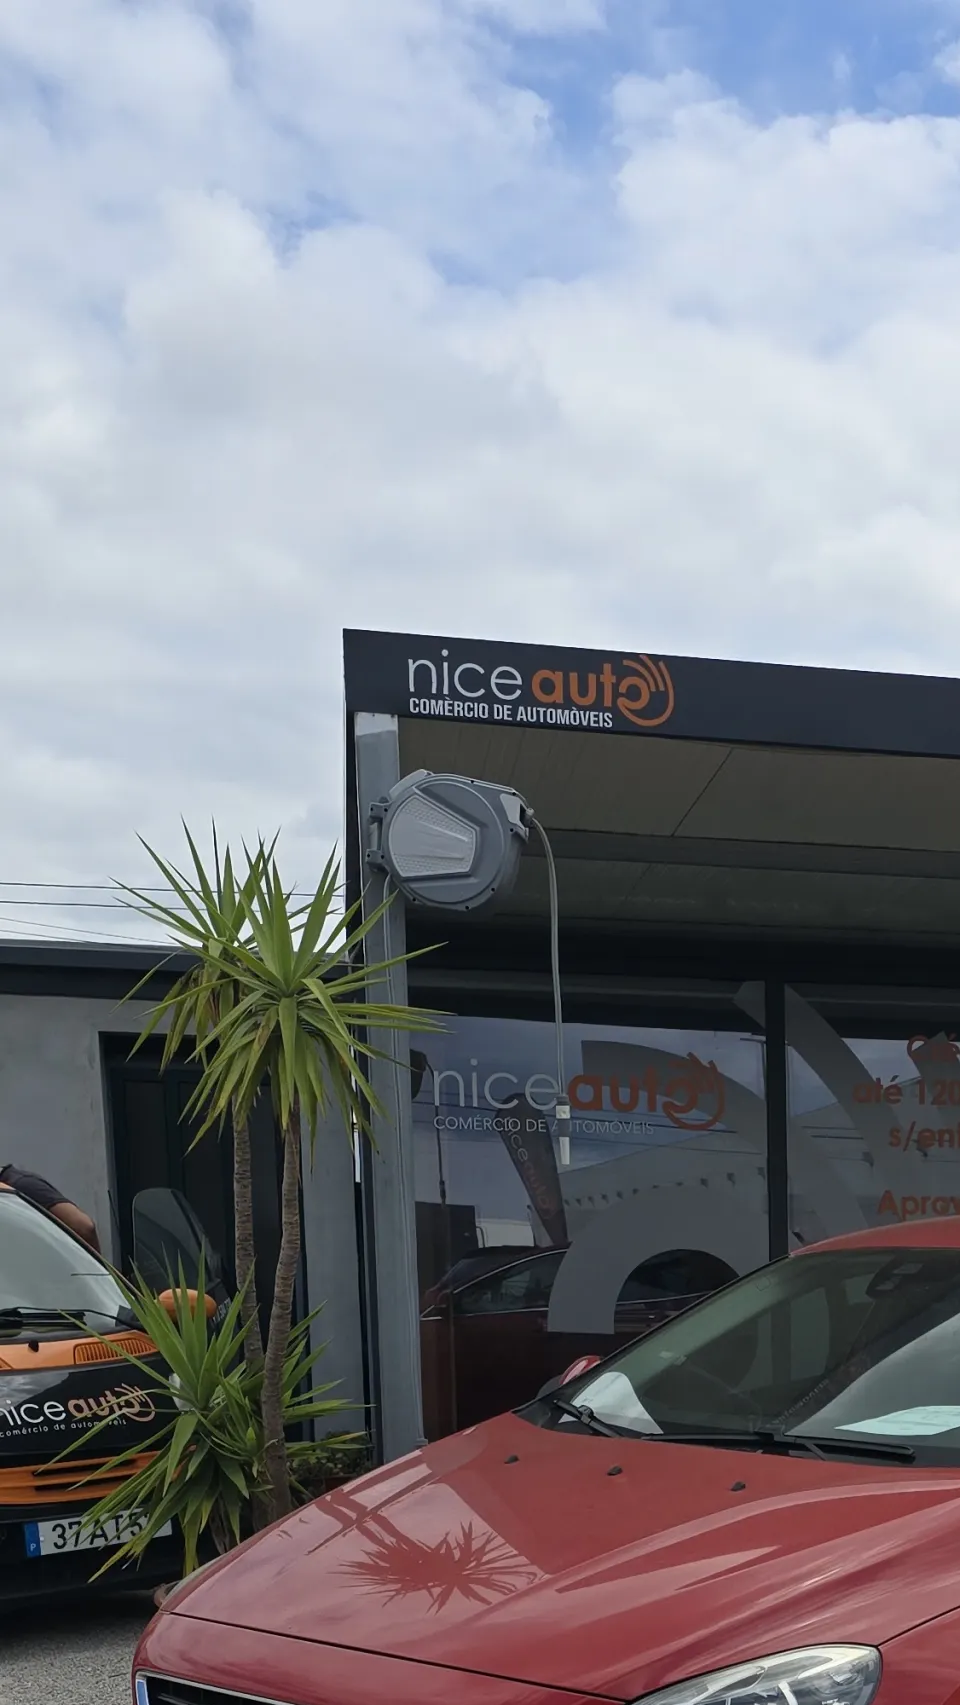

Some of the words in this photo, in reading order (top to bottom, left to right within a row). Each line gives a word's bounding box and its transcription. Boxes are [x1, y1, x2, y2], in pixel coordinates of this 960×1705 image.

[494, 705, 513, 721] DE
[852, 1074, 903, 1104] até
[526, 1118, 547, 1133] DE
[54, 1422, 66, 1431] de
[71, 1417, 127, 1430] automveis
[30, 1543, 37, 1551] P
